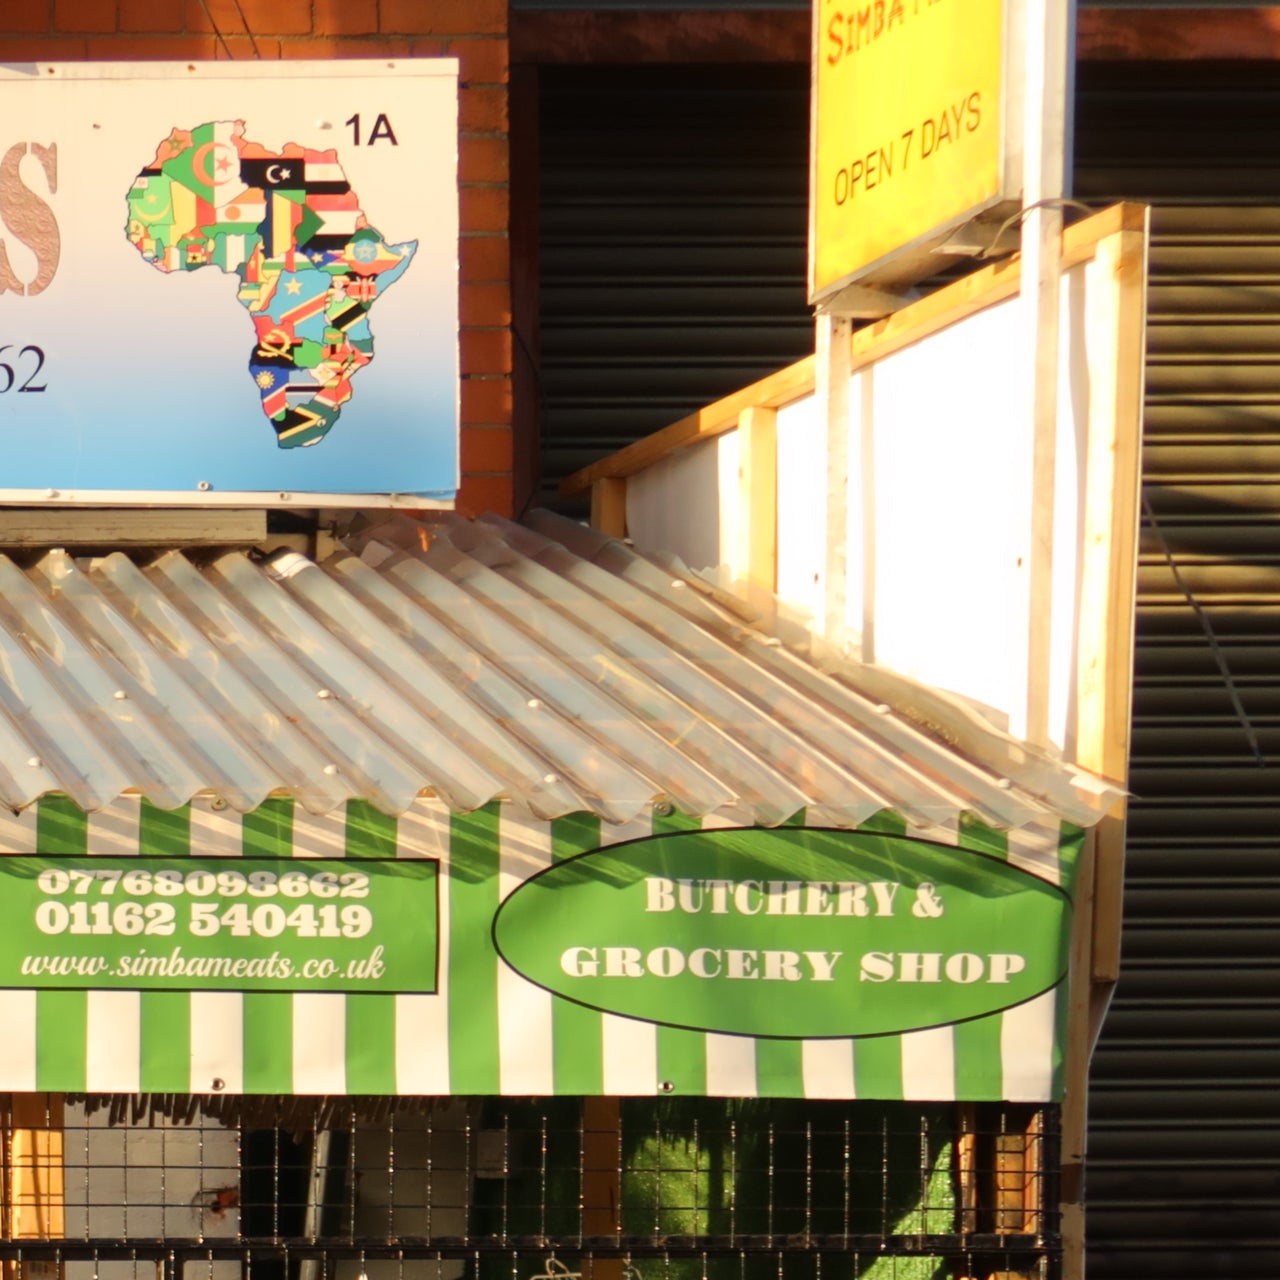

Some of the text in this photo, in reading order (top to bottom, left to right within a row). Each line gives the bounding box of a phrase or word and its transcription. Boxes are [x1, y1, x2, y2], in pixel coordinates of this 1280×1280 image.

[345, 113, 398, 146] 1A
[834, 91, 981, 206] OPEN 7 DAYS
[37, 869, 370, 898] 07768098662
[645, 876, 945, 918] BUTCHERY &
[34, 901, 374, 939] 01162 540419
[19, 945, 386, 980] www.simbameats.co.uk
[559, 946, 1027, 984] GROCERY SHOP
